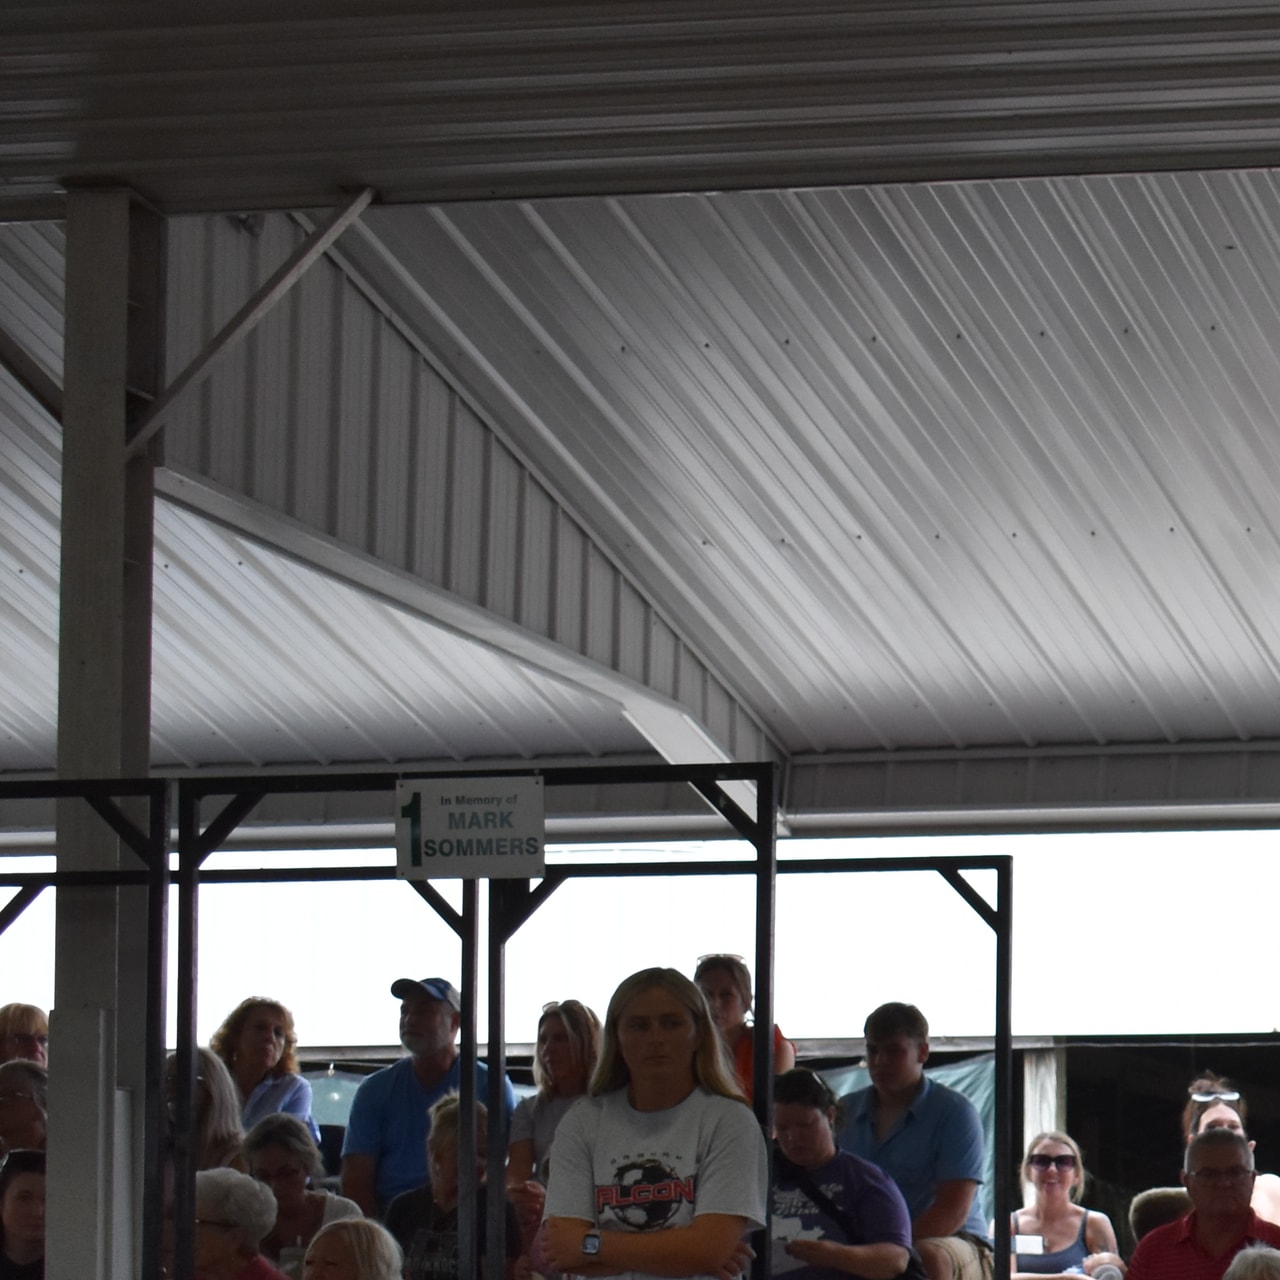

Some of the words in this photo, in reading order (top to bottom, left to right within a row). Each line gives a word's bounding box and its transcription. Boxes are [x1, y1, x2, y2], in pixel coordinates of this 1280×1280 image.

[440, 796, 452, 806] In
[455, 795, 502, 807] Memory
[505, 794, 518, 804] of
[401, 792, 422, 867] 1
[448, 811, 514, 830] MARK
[423, 837, 539, 857] SOMMERS
[595, 1177, 694, 1211] ALCON
